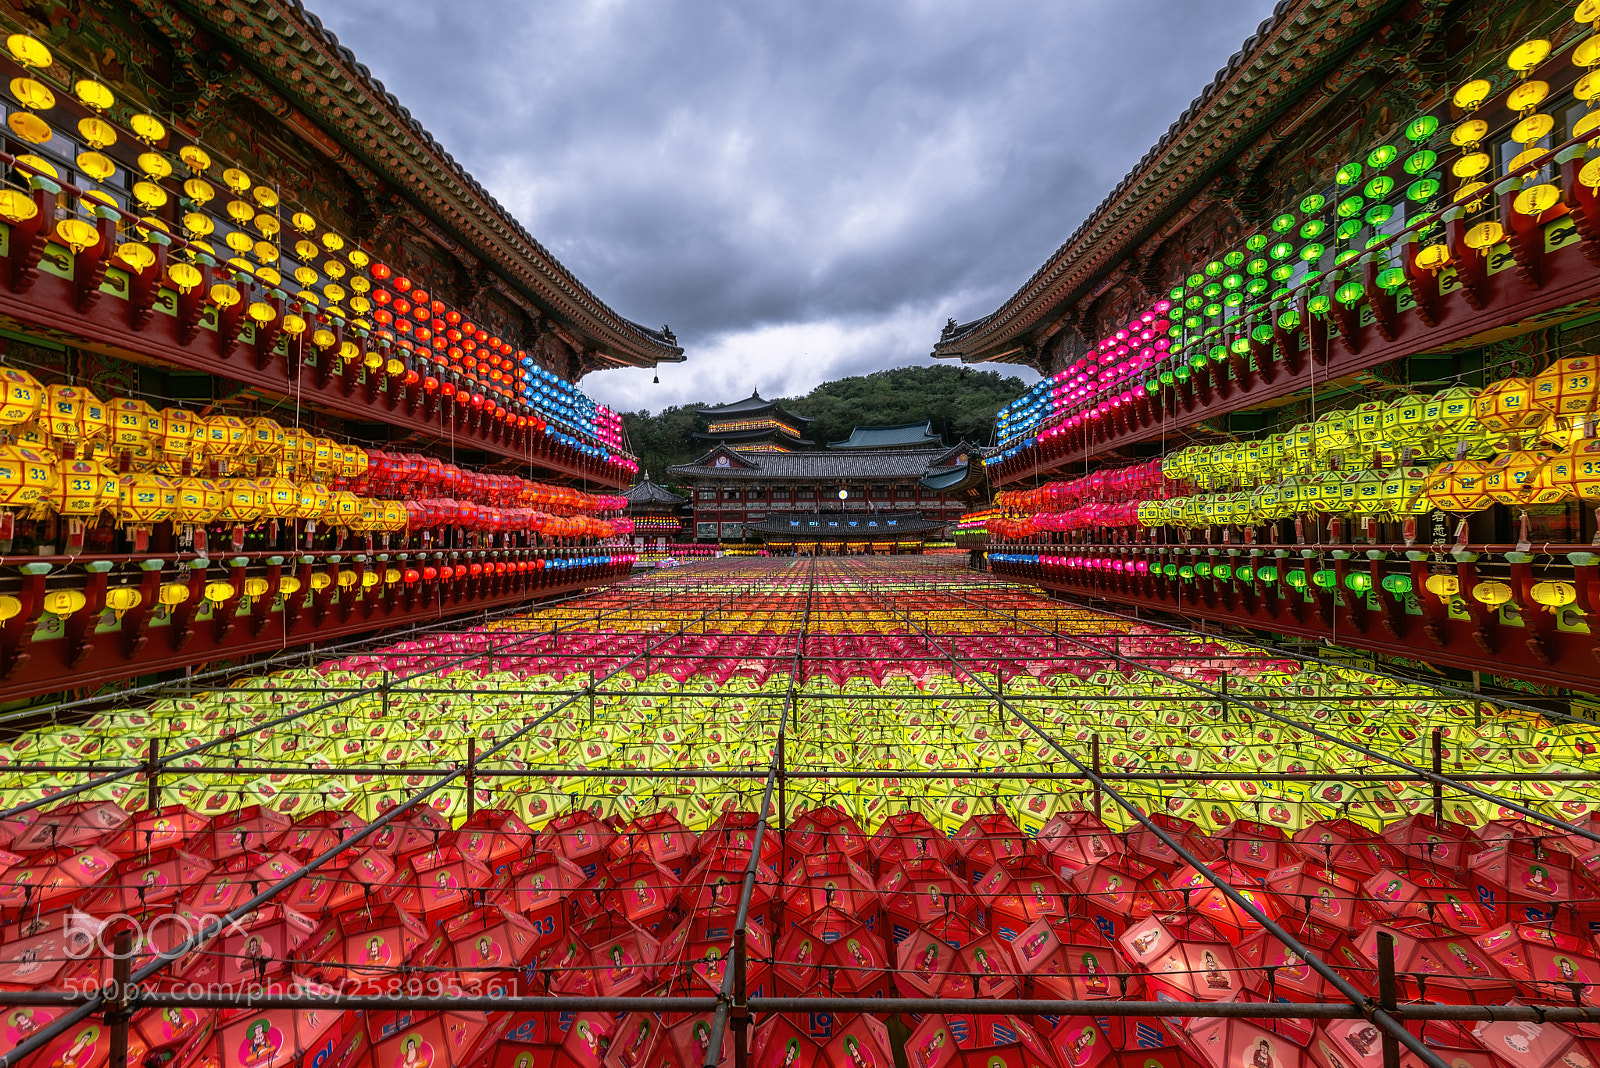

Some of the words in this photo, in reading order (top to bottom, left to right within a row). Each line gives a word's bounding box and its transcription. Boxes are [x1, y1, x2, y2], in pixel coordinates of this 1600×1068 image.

[1568, 376, 1588, 389] 33
[14, 388, 31, 400] 33
[1504, 395, 1520, 407] 인
[1447, 404, 1464, 414] 양
[122, 415, 138, 425] 33
[148, 418, 159, 430] 인
[1385, 413, 1394, 424] 33
[1403, 409, 1416, 420] 인
[172, 424, 186, 434] 33
[1316, 425, 1325, 434] 33
[30, 468, 47, 481] 33
[1488, 474, 1500, 485] 33
[73, 479, 91, 490] 33
[105, 481, 116, 492] 인
[1361, 486, 1376, 496] 양
[277, 491, 288, 500] 인
[342, 503, 351, 512] 인
[1476, 884, 1496, 913] 인
